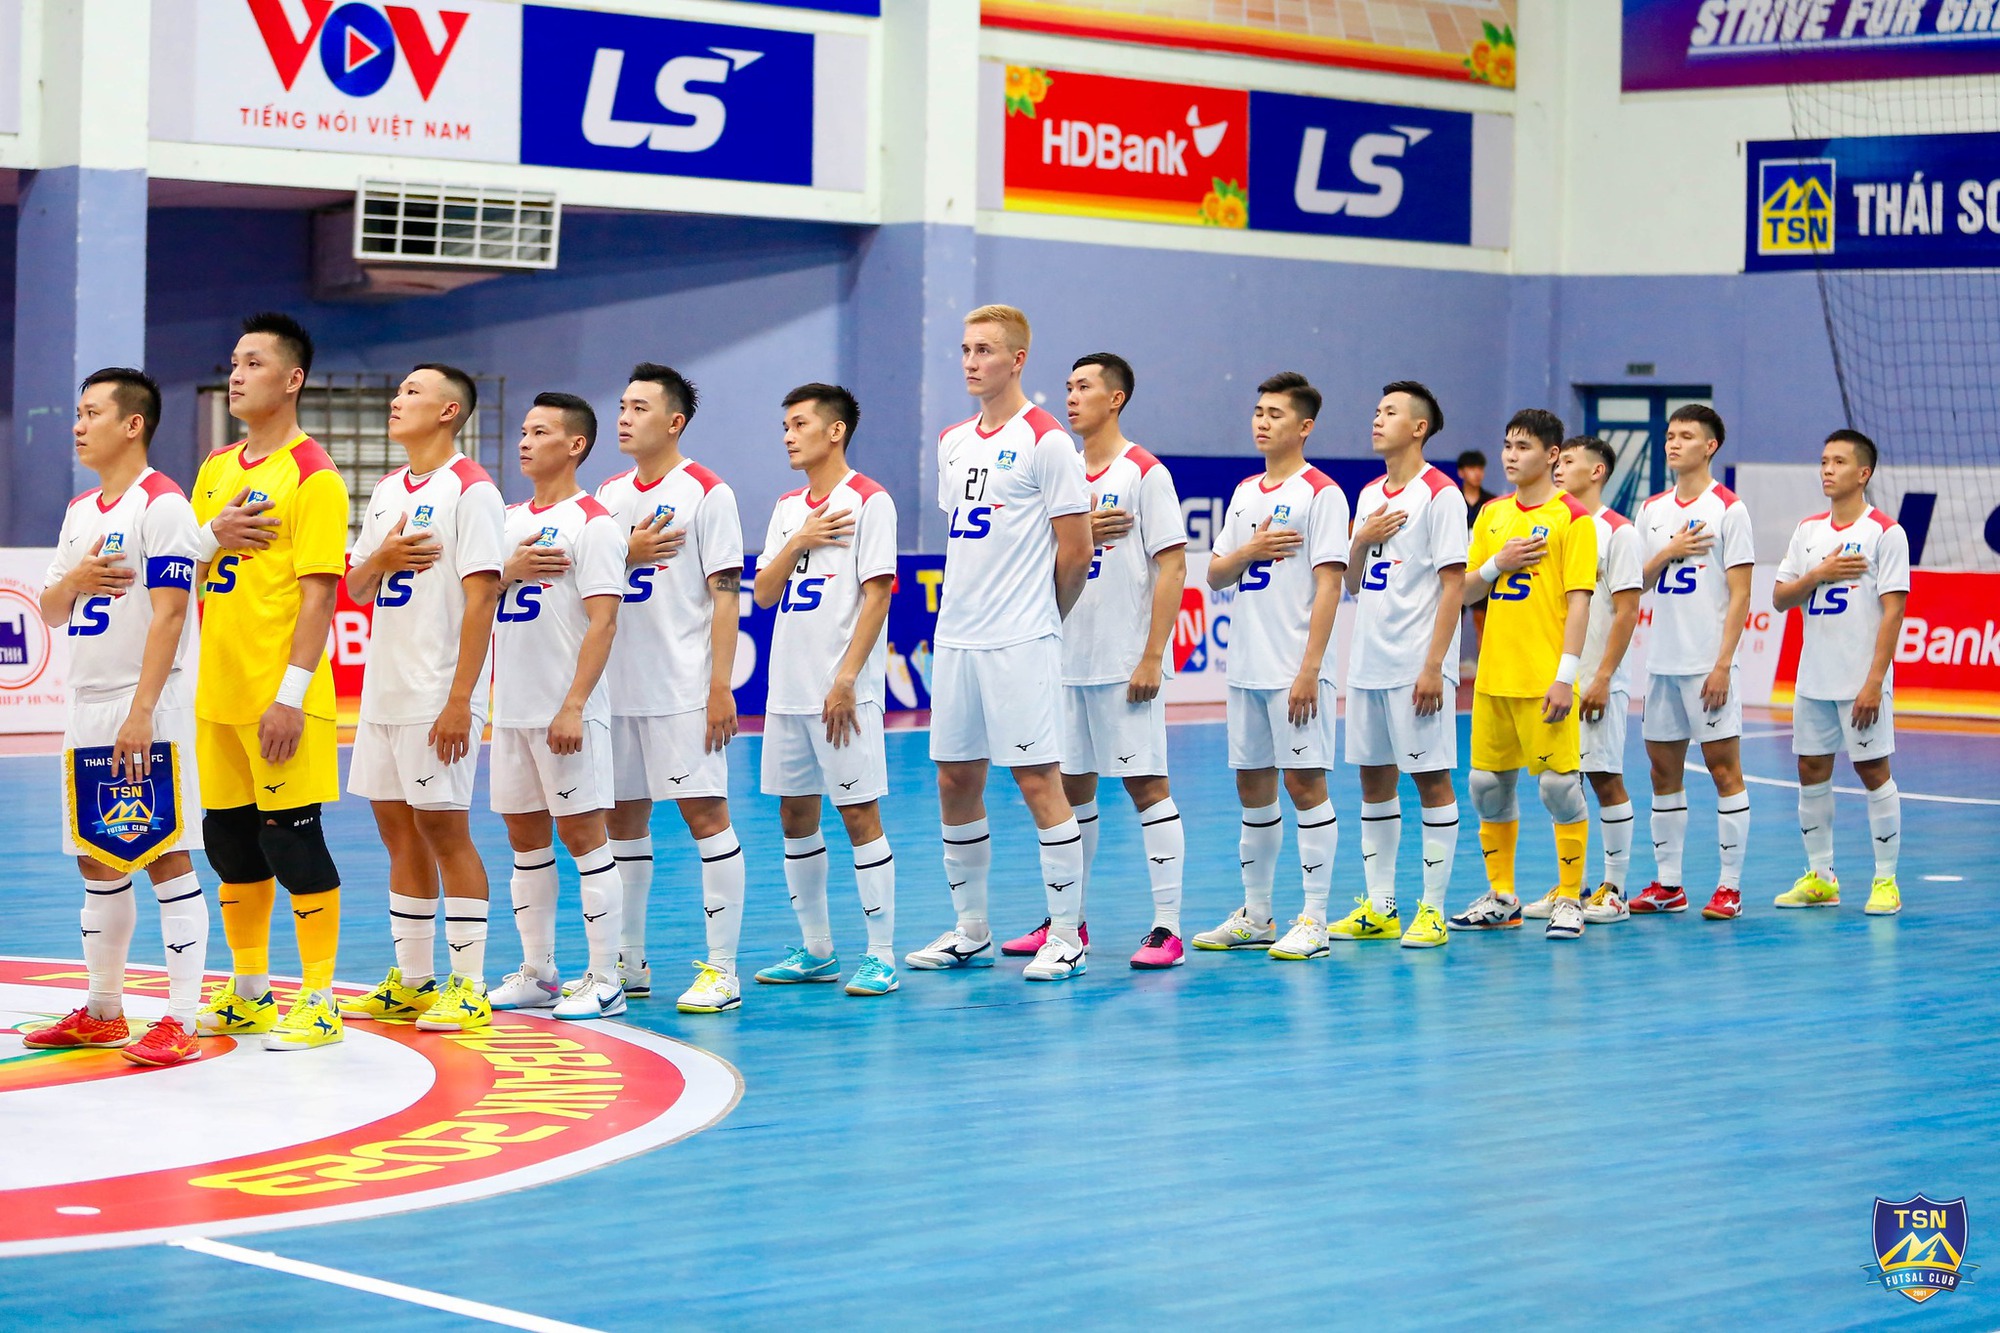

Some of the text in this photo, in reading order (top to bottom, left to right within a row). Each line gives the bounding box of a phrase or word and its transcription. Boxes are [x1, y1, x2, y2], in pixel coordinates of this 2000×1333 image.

[1690, 0, 1831, 46] STRIVE
[1840, 0, 1926, 38] FOR
[581, 47, 730, 153] LS
[240, 103, 472, 141] TIẾNG NÓI VIỆT NAM
[1042, 118, 1188, 176] HDBank
[1294, 126, 1406, 219] LS
[1852, 170, 1944, 236] THÁI
[1766, 216, 1828, 244] TSN
[965, 467, 989, 502] 27
[948, 506, 992, 540] LS
[1657, 567, 1697, 595] LS
[1809, 588, 1849, 615] LS
[84, 757, 105, 767] THAI
[151, 753, 164, 763] FC
[109, 786, 143, 799] TSN
[107, 823, 149, 835] FUTSAL CLUB
[187, 1024, 625, 1198] HDBANK 2023
